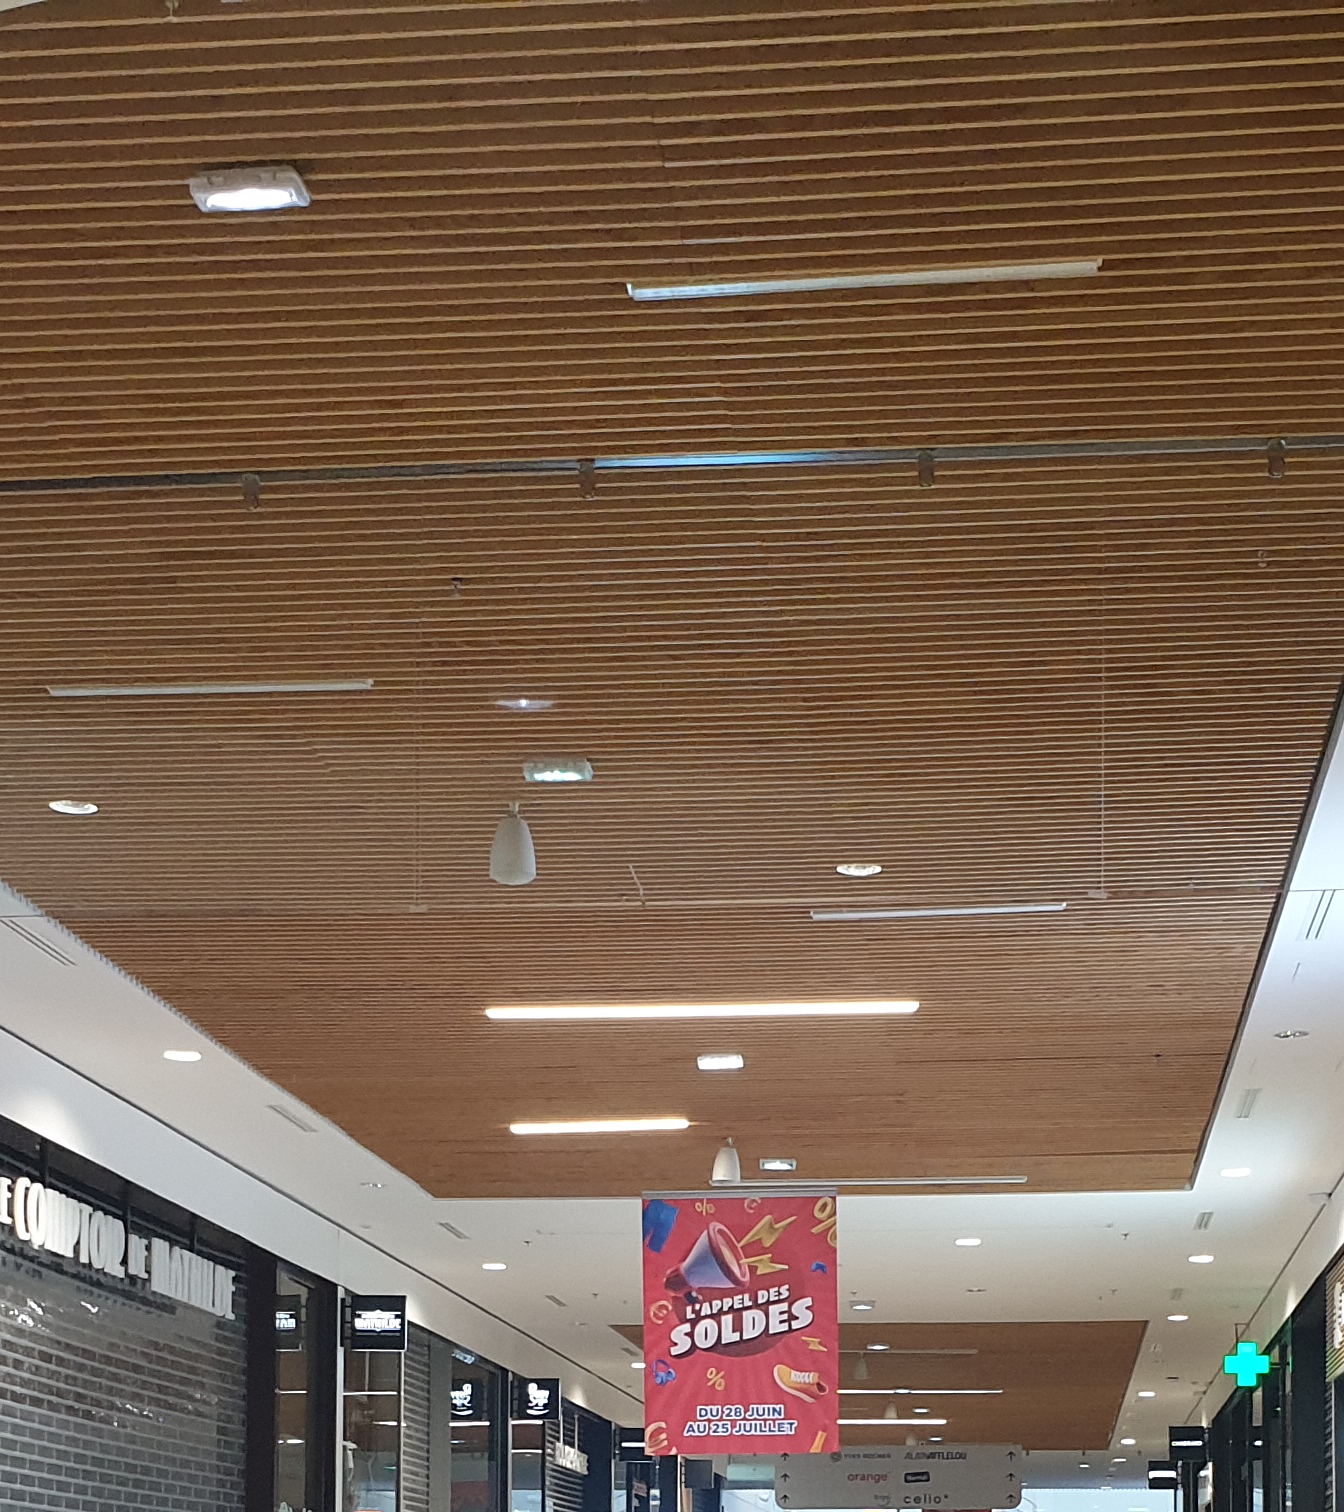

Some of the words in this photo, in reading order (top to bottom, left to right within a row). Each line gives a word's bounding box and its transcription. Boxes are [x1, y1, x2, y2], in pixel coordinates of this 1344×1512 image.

[685, 1292, 753, 1320] L'APPEL
[757, 1284, 790, 1304] DES
[669, 1296, 814, 1356] SOLDES
[697, 1406, 720, 1419] DU
[723, 1405, 744, 1419] 28
[747, 1404, 785, 1419] JUIN
[684, 1422, 708, 1436] AU
[710, 1421, 731, 1435] 25
[734, 1420, 797, 1435] JUILLET
[847, 1473, 888, 1484] orange
